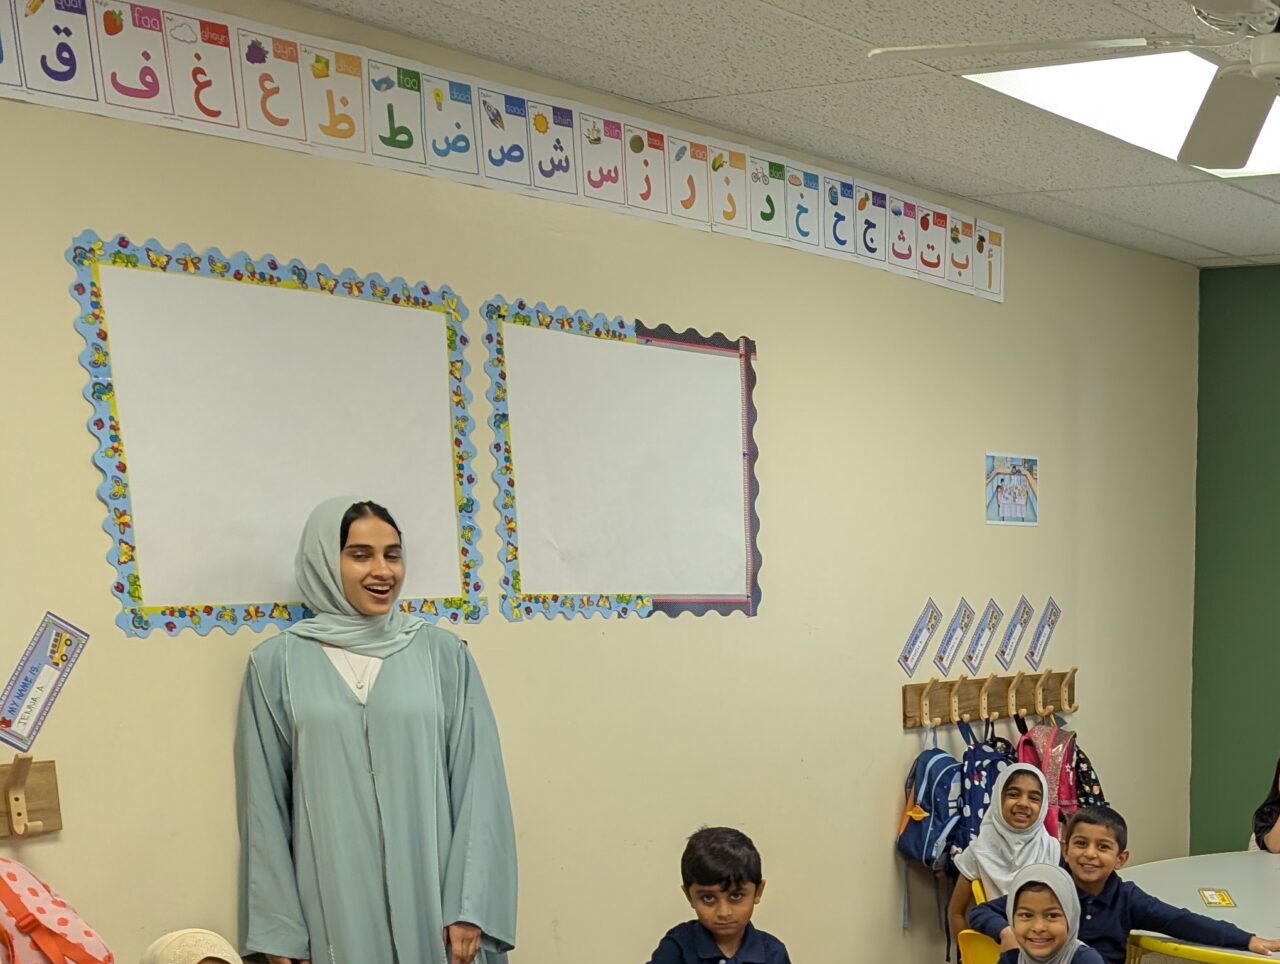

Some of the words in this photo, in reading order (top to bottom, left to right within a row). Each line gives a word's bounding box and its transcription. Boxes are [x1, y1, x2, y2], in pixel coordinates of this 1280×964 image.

[134, 6, 160, 30] faa
[40, 24, 77, 82] ق
[110, 50, 160, 99] ف
[191, 52, 222, 118] غ
[258, 72, 290, 127] ع
[318, 89, 356, 139] ظ
[378, 102, 414, 149] ط
[432, 121, 470, 158] ض
[487, 143, 525, 167] ص
[538, 137, 570, 178] ش
[586, 165, 619, 189] س
[639, 158, 652, 201] ز
[680, 174, 696, 210] ر
[722, 175, 737, 221] ذ
[760, 194, 776, 222] د
[795, 192, 810, 237] خ
[832, 211, 848, 246] ح
[862, 218, 878, 254] ج
[891, 228, 912, 260] ث
[920, 243, 941, 269] ت
[950, 252, 970, 277] ب
[7, 700, 20, 716] MY
[14, 676, 33, 701] NAME
[17, 696, 40, 726] JENNA
[36, 685, 45, 693] A
